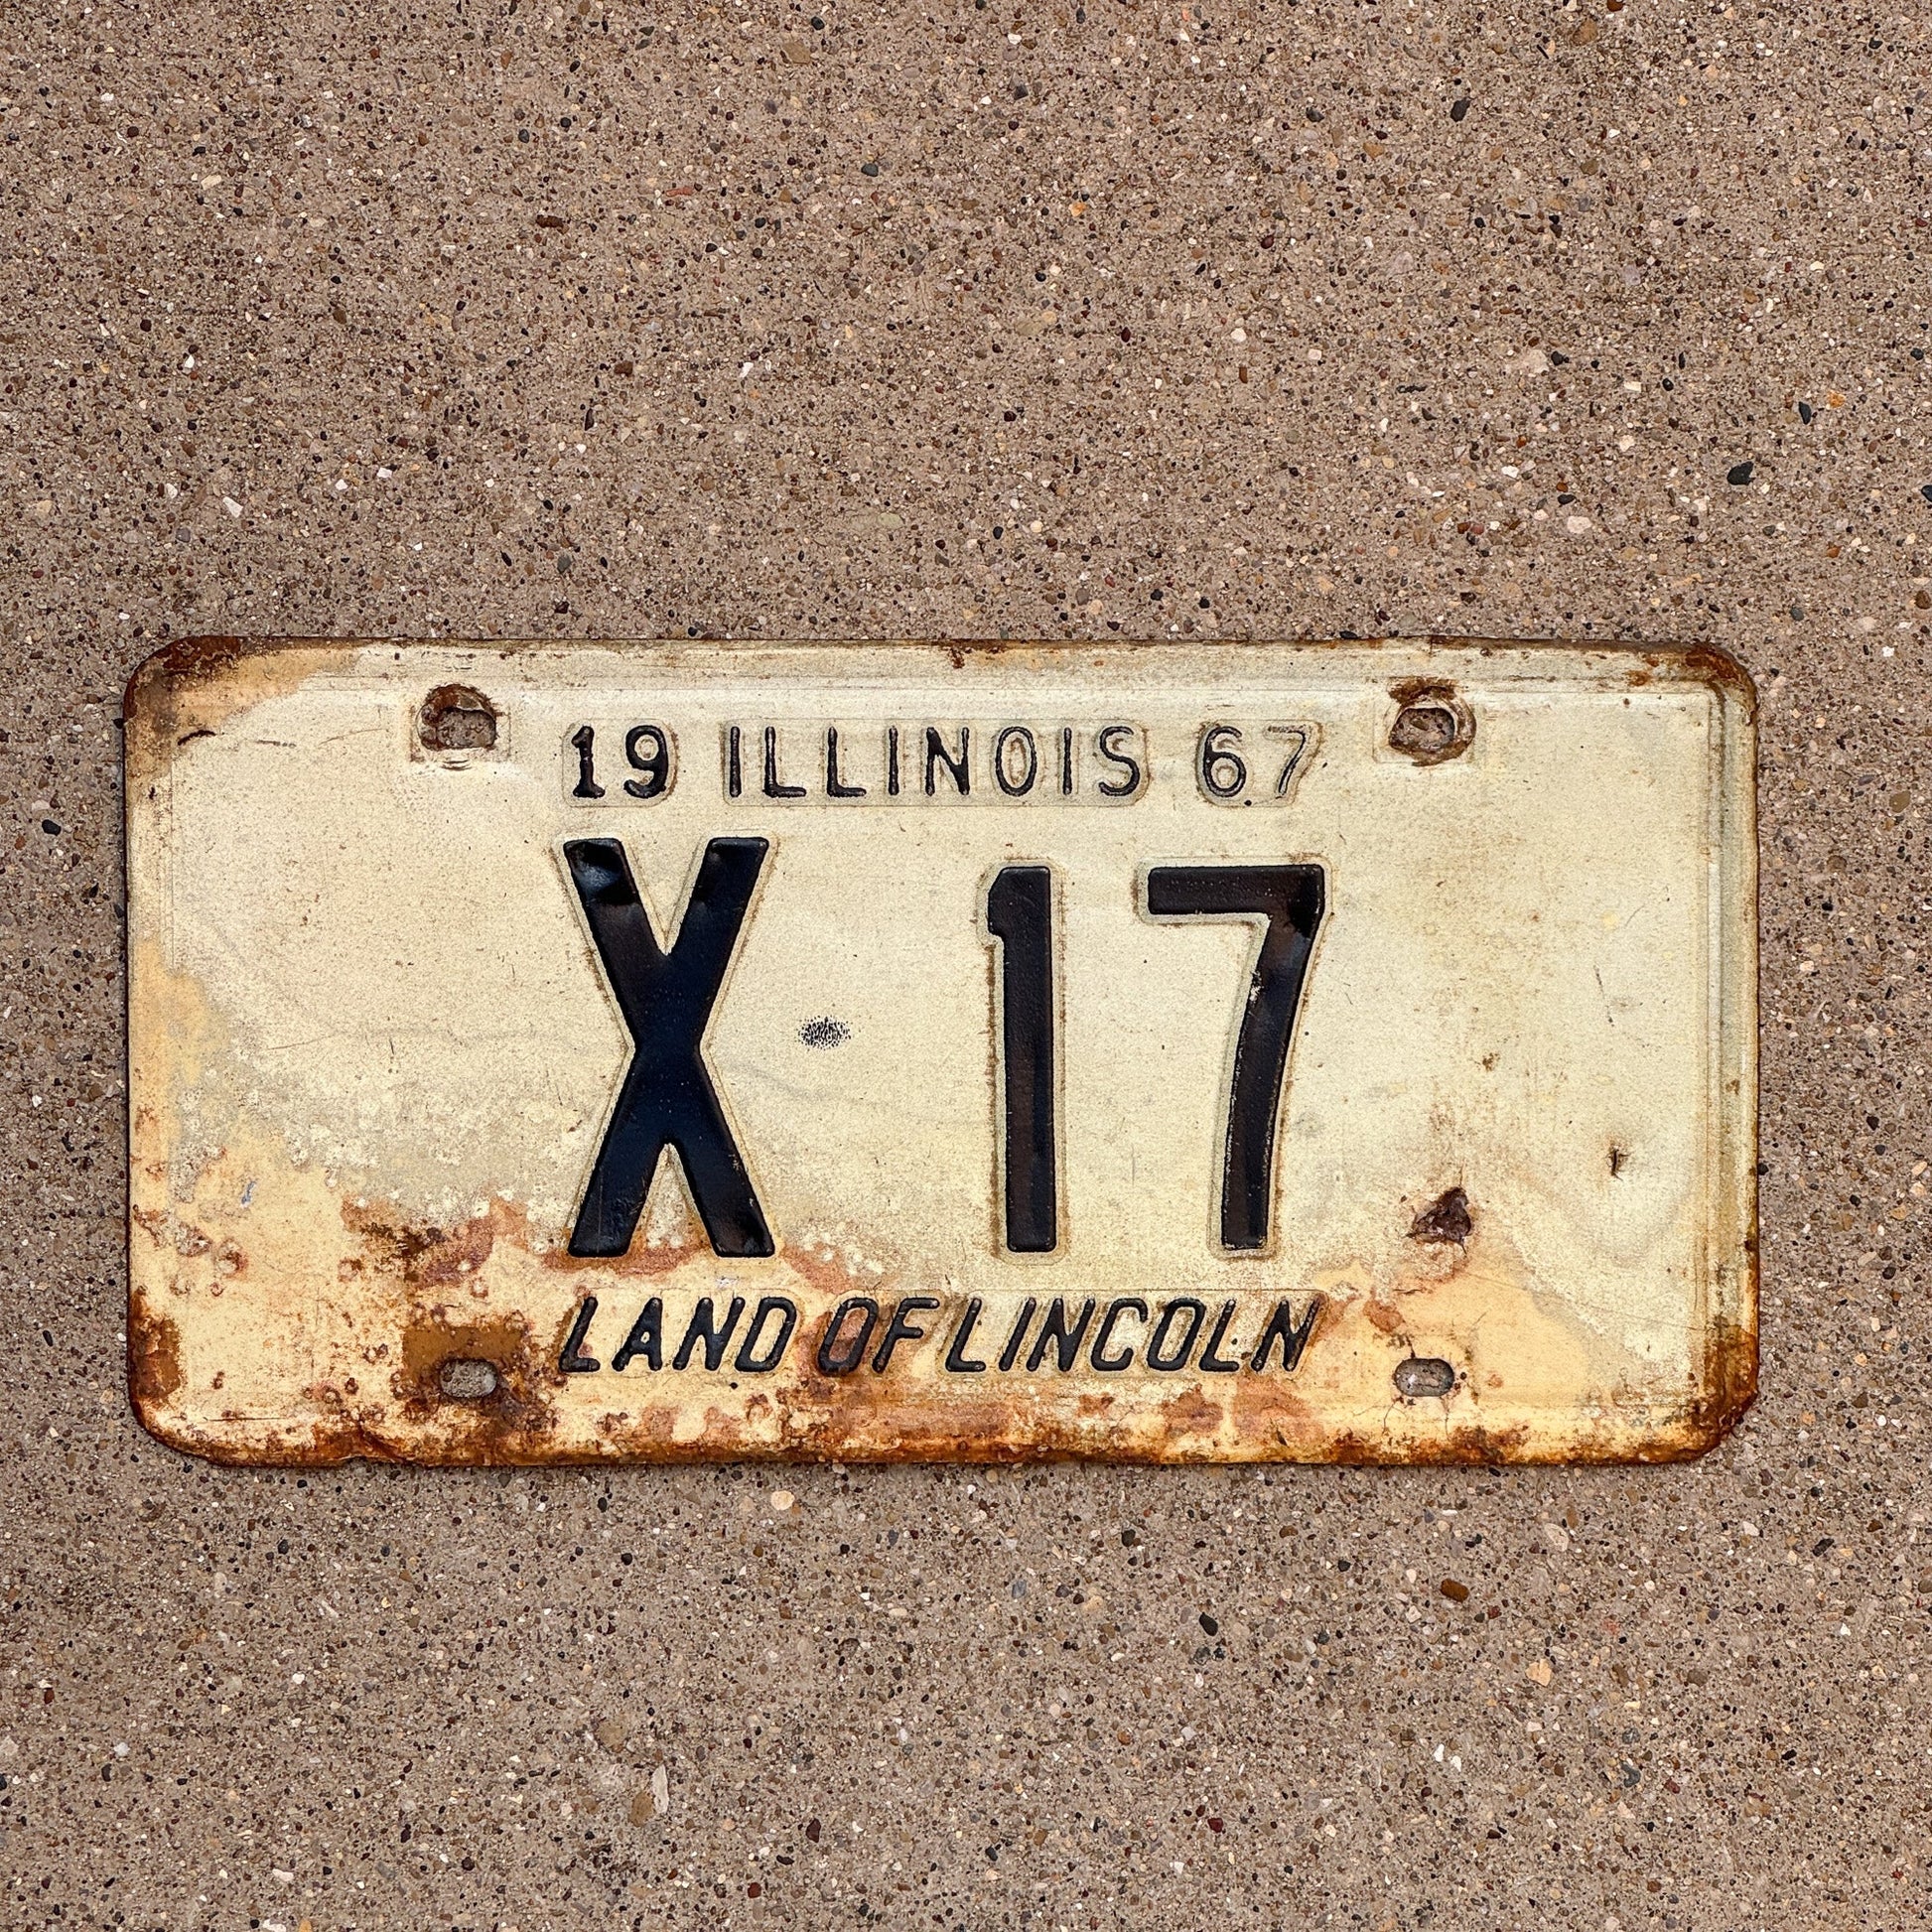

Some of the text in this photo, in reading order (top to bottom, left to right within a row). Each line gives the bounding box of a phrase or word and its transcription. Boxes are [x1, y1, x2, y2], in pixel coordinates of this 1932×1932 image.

[571, 724, 1309, 799] 19 ILLINOIS 67
[562, 836, 1325, 1258] X 17
[558, 1296, 1322, 1374] LAND OF LINCOLN
